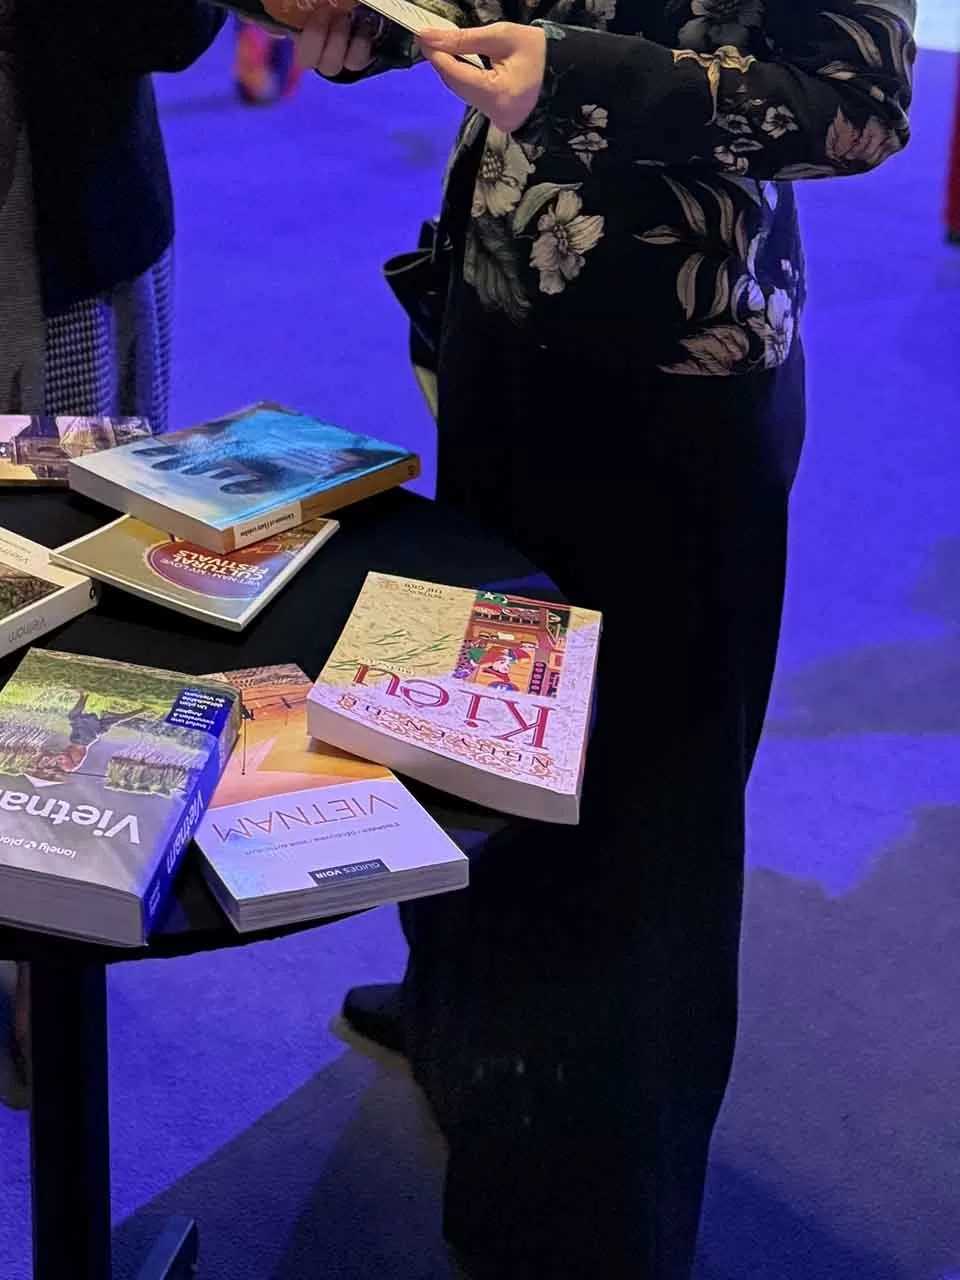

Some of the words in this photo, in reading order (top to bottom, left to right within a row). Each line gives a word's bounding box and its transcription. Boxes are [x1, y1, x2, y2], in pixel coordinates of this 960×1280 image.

[159, 558, 189, 570] LOVE
[171, 553, 263, 581] CULTURAL
[175, 549, 269, 575] FESTIVALS
[183, 690, 215, 702] Vietnam
[211, 792, 399, 844] VIETNAM
[165, 787, 205, 875] Vietnam
[37, 840, 78, 859] lonely
[314, 868, 342, 880] VOIR
[341, 861, 381, 875] GUIDES
